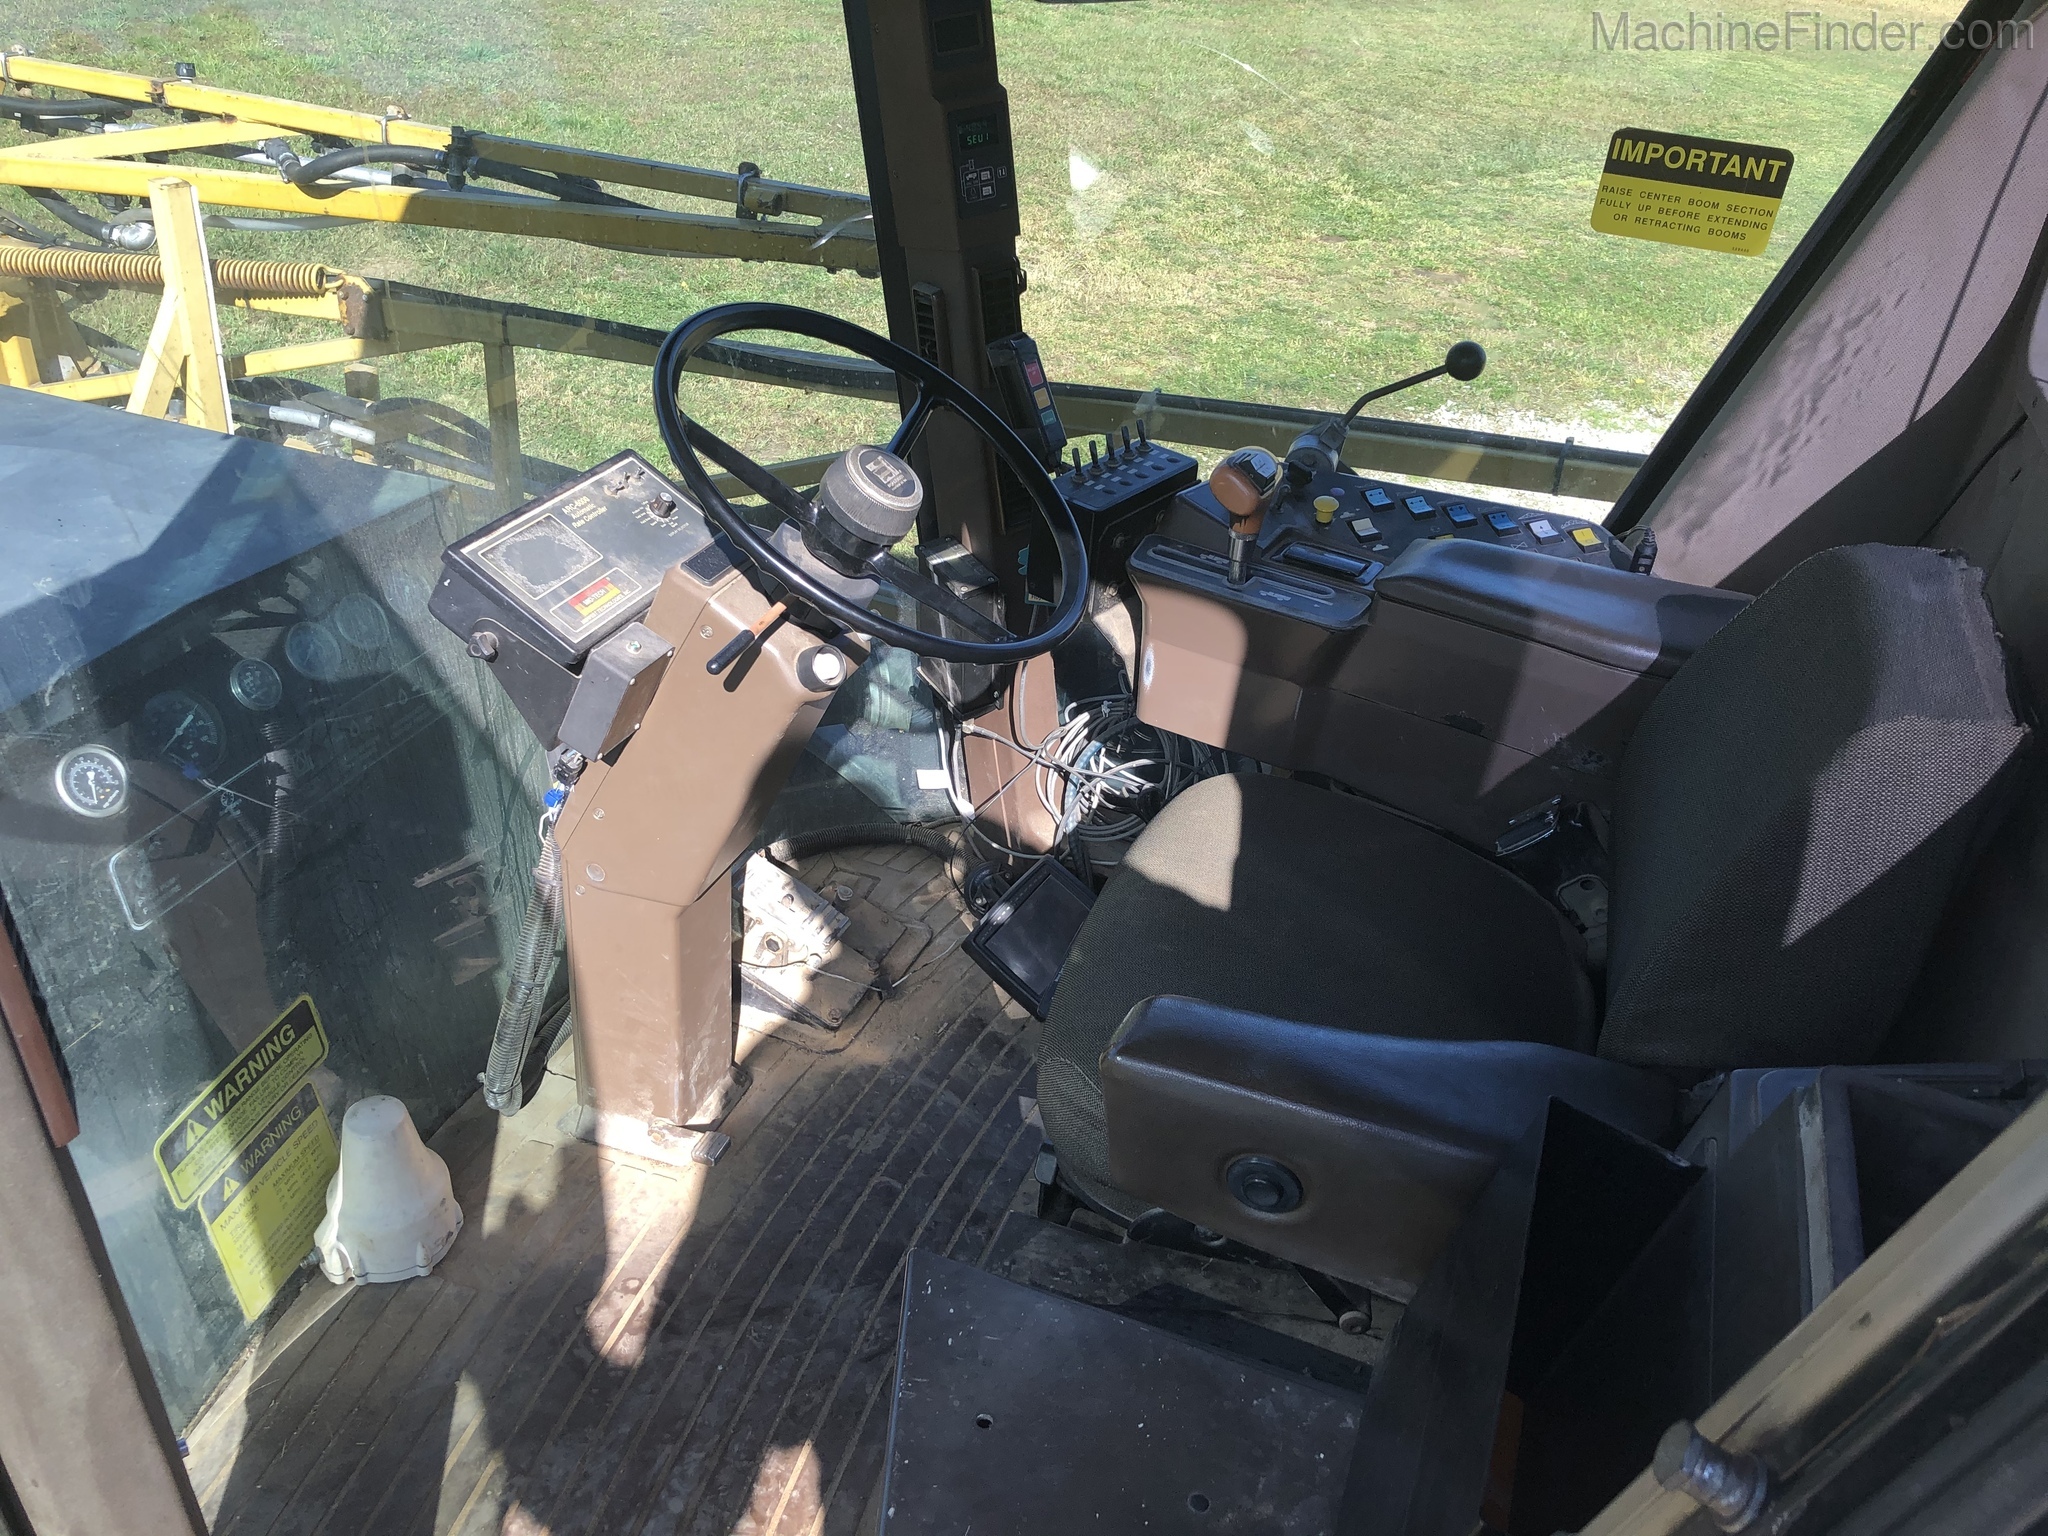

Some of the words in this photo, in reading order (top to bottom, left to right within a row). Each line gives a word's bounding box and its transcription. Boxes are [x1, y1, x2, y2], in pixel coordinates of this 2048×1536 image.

[1612, 138, 1787, 183] IMPORTANT
[1599, 198, 1631, 210] FULLY
[1638, 204, 1651, 212] UP
[1658, 207, 1700, 220] BEFORE
[1707, 215, 1768, 231] EXTENDING
[1601, 185, 1633, 197] RAISE
[1639, 191, 1682, 204] CENTER
[1688, 198, 1720, 210] BOOM
[1726, 204, 1774, 218] SECTION
[1613, 213, 1628, 222] OR
[1634, 217, 1701, 234] RETRACTING
[1708, 228, 1747, 241] BOOMS
[282, 1030, 312, 1065] OPERATING
[203, 1023, 296, 1120] WARNING
[240, 1104, 303, 1175] WARNING
[219, 1183, 260, 1232] MAXIMUM
[258, 1147, 292, 1188] VEHICLE
[291, 1117, 318, 1151] SPEED
